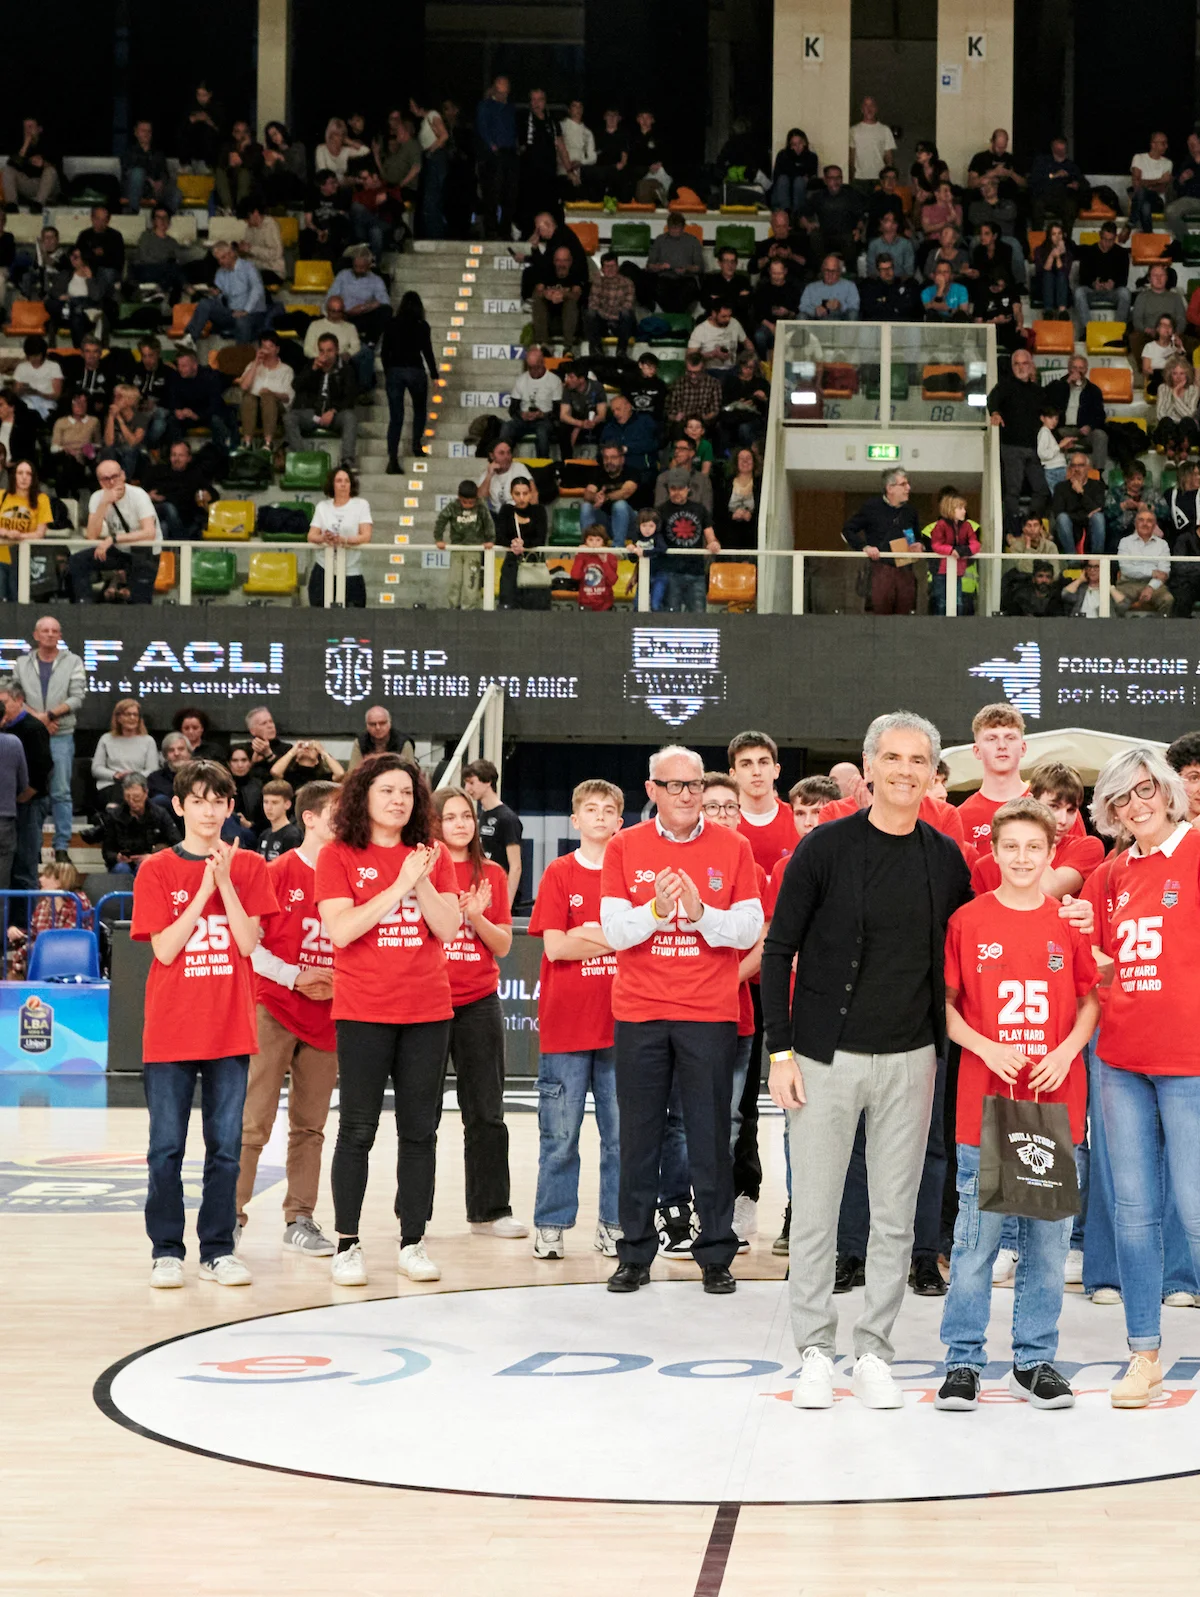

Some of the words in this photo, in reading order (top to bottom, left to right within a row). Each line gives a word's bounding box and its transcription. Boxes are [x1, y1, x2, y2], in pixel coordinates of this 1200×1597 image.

[805, 37, 819, 57] K
[968, 36, 982, 56] K
[476, 346, 506, 359] FILA
[512, 347, 523, 359] 7
[465, 394, 496, 406] FILA
[500, 394, 510, 406] 6
[133, 641, 284, 673] ACLI
[383, 650, 448, 670] FIP
[1058, 657, 1188, 674] FONDAZIONE
[180, 677, 281, 698] semplice
[381, 674, 470, 697] TRENTINO
[525, 676, 578, 698] ADIGE
[1058, 687, 1094, 704] per
[1100, 685, 1120, 704] lo
[1127, 684, 1186, 705] Sport
[634, 870, 656, 883] 30
[185, 915, 230, 952] 25
[378, 926, 400, 936] PLAY
[400, 926, 419, 936] HARD
[377, 937, 403, 948] STUDY
[403, 937, 423, 948] HARD
[653, 935, 673, 946] PLAY
[675, 935, 697, 946] HARD
[1117, 915, 1163, 963] 25
[443, 942, 462, 951] PLAY
[651, 946, 677, 957] STUDY
[678, 946, 700, 957] HARD
[977, 942, 1003, 959] 30
[185, 954, 207, 966] PLAY
[208, 953, 229, 965] HARD
[184, 966, 212, 978] STUDY
[212, 964, 233, 976] HARD
[581, 966, 606, 977] STUDY
[1120, 966, 1134, 979] PLAY
[1135, 965, 1157, 977] HARD
[1136, 979, 1162, 992] HARD
[997, 980, 1049, 1025] 25
[23, 1018, 49, 1030] LBA
[999, 1029, 1022, 1041] PLAY
[1024, 1029, 1045, 1041] HARD
[1027, 1044, 1048, 1056] HARD
